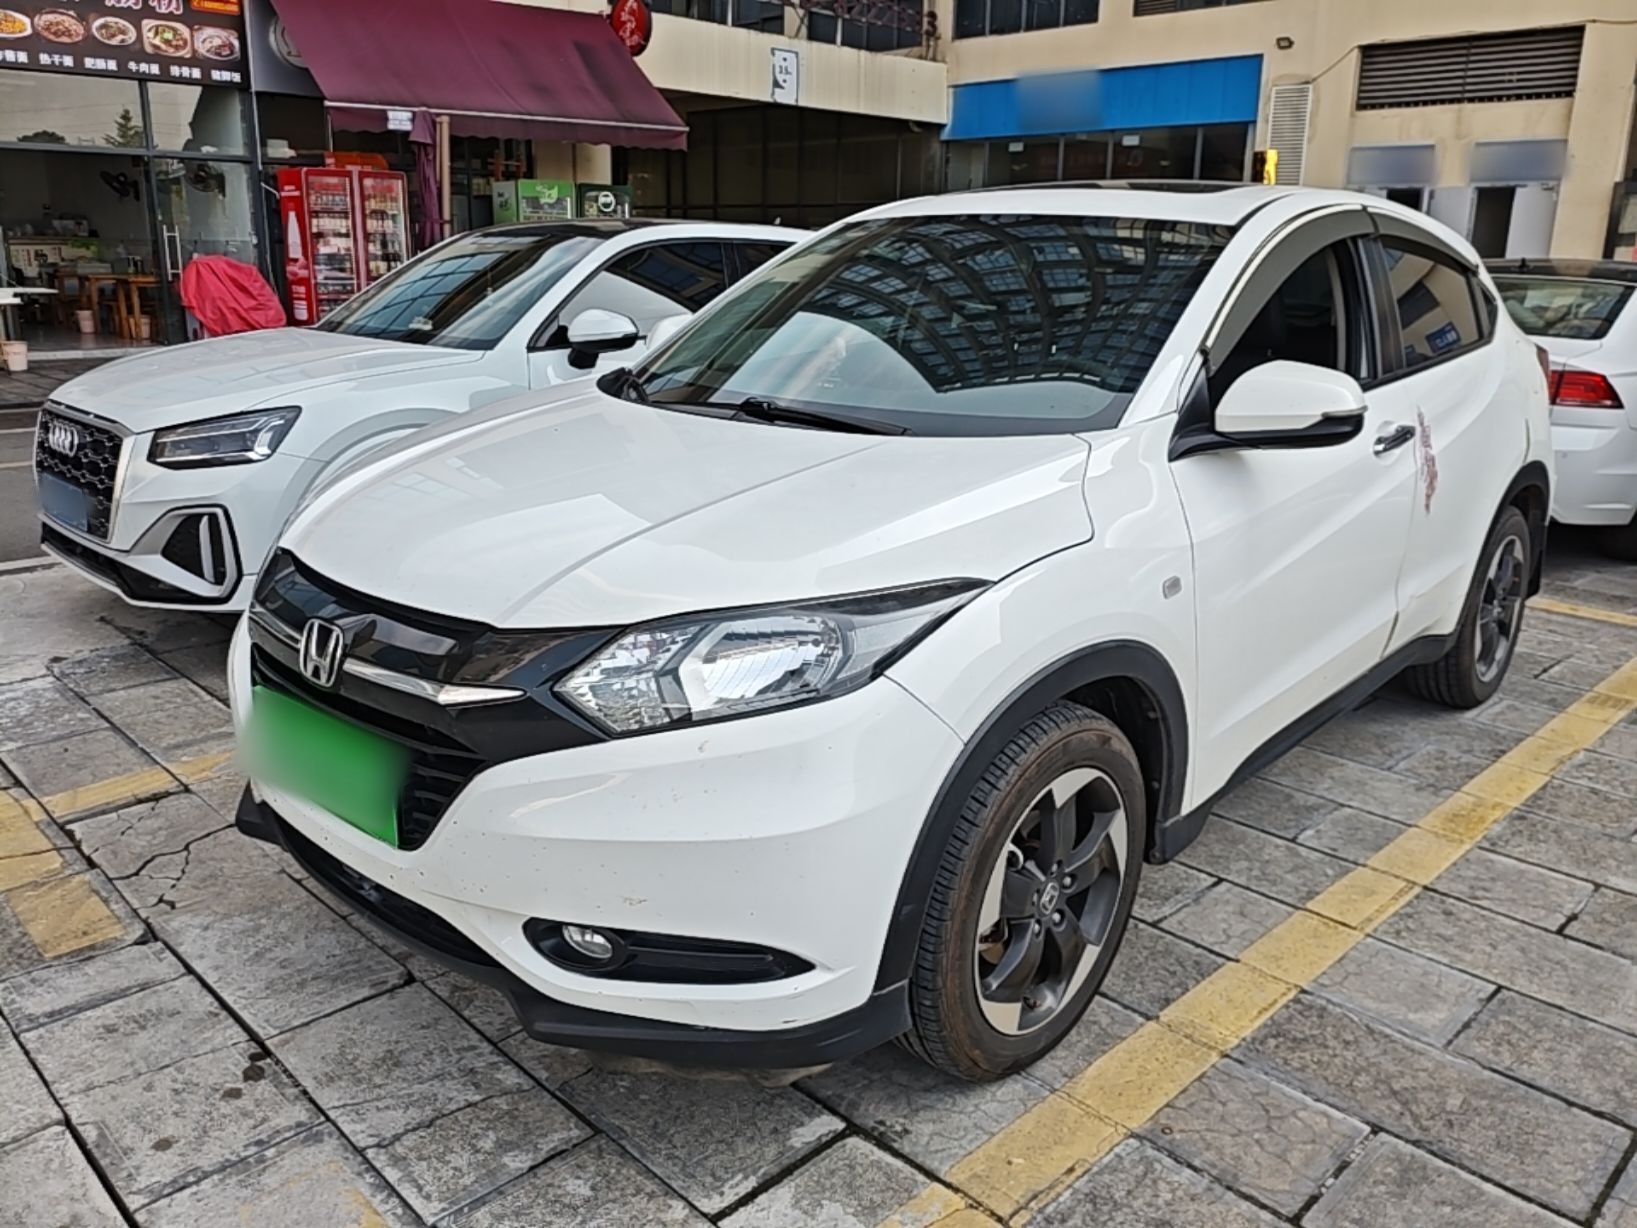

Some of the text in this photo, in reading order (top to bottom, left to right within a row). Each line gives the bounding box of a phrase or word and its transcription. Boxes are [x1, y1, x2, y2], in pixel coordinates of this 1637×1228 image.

[39, 52, 74, 67] 热干面
[128, 61, 160, 75] 牛肉面
